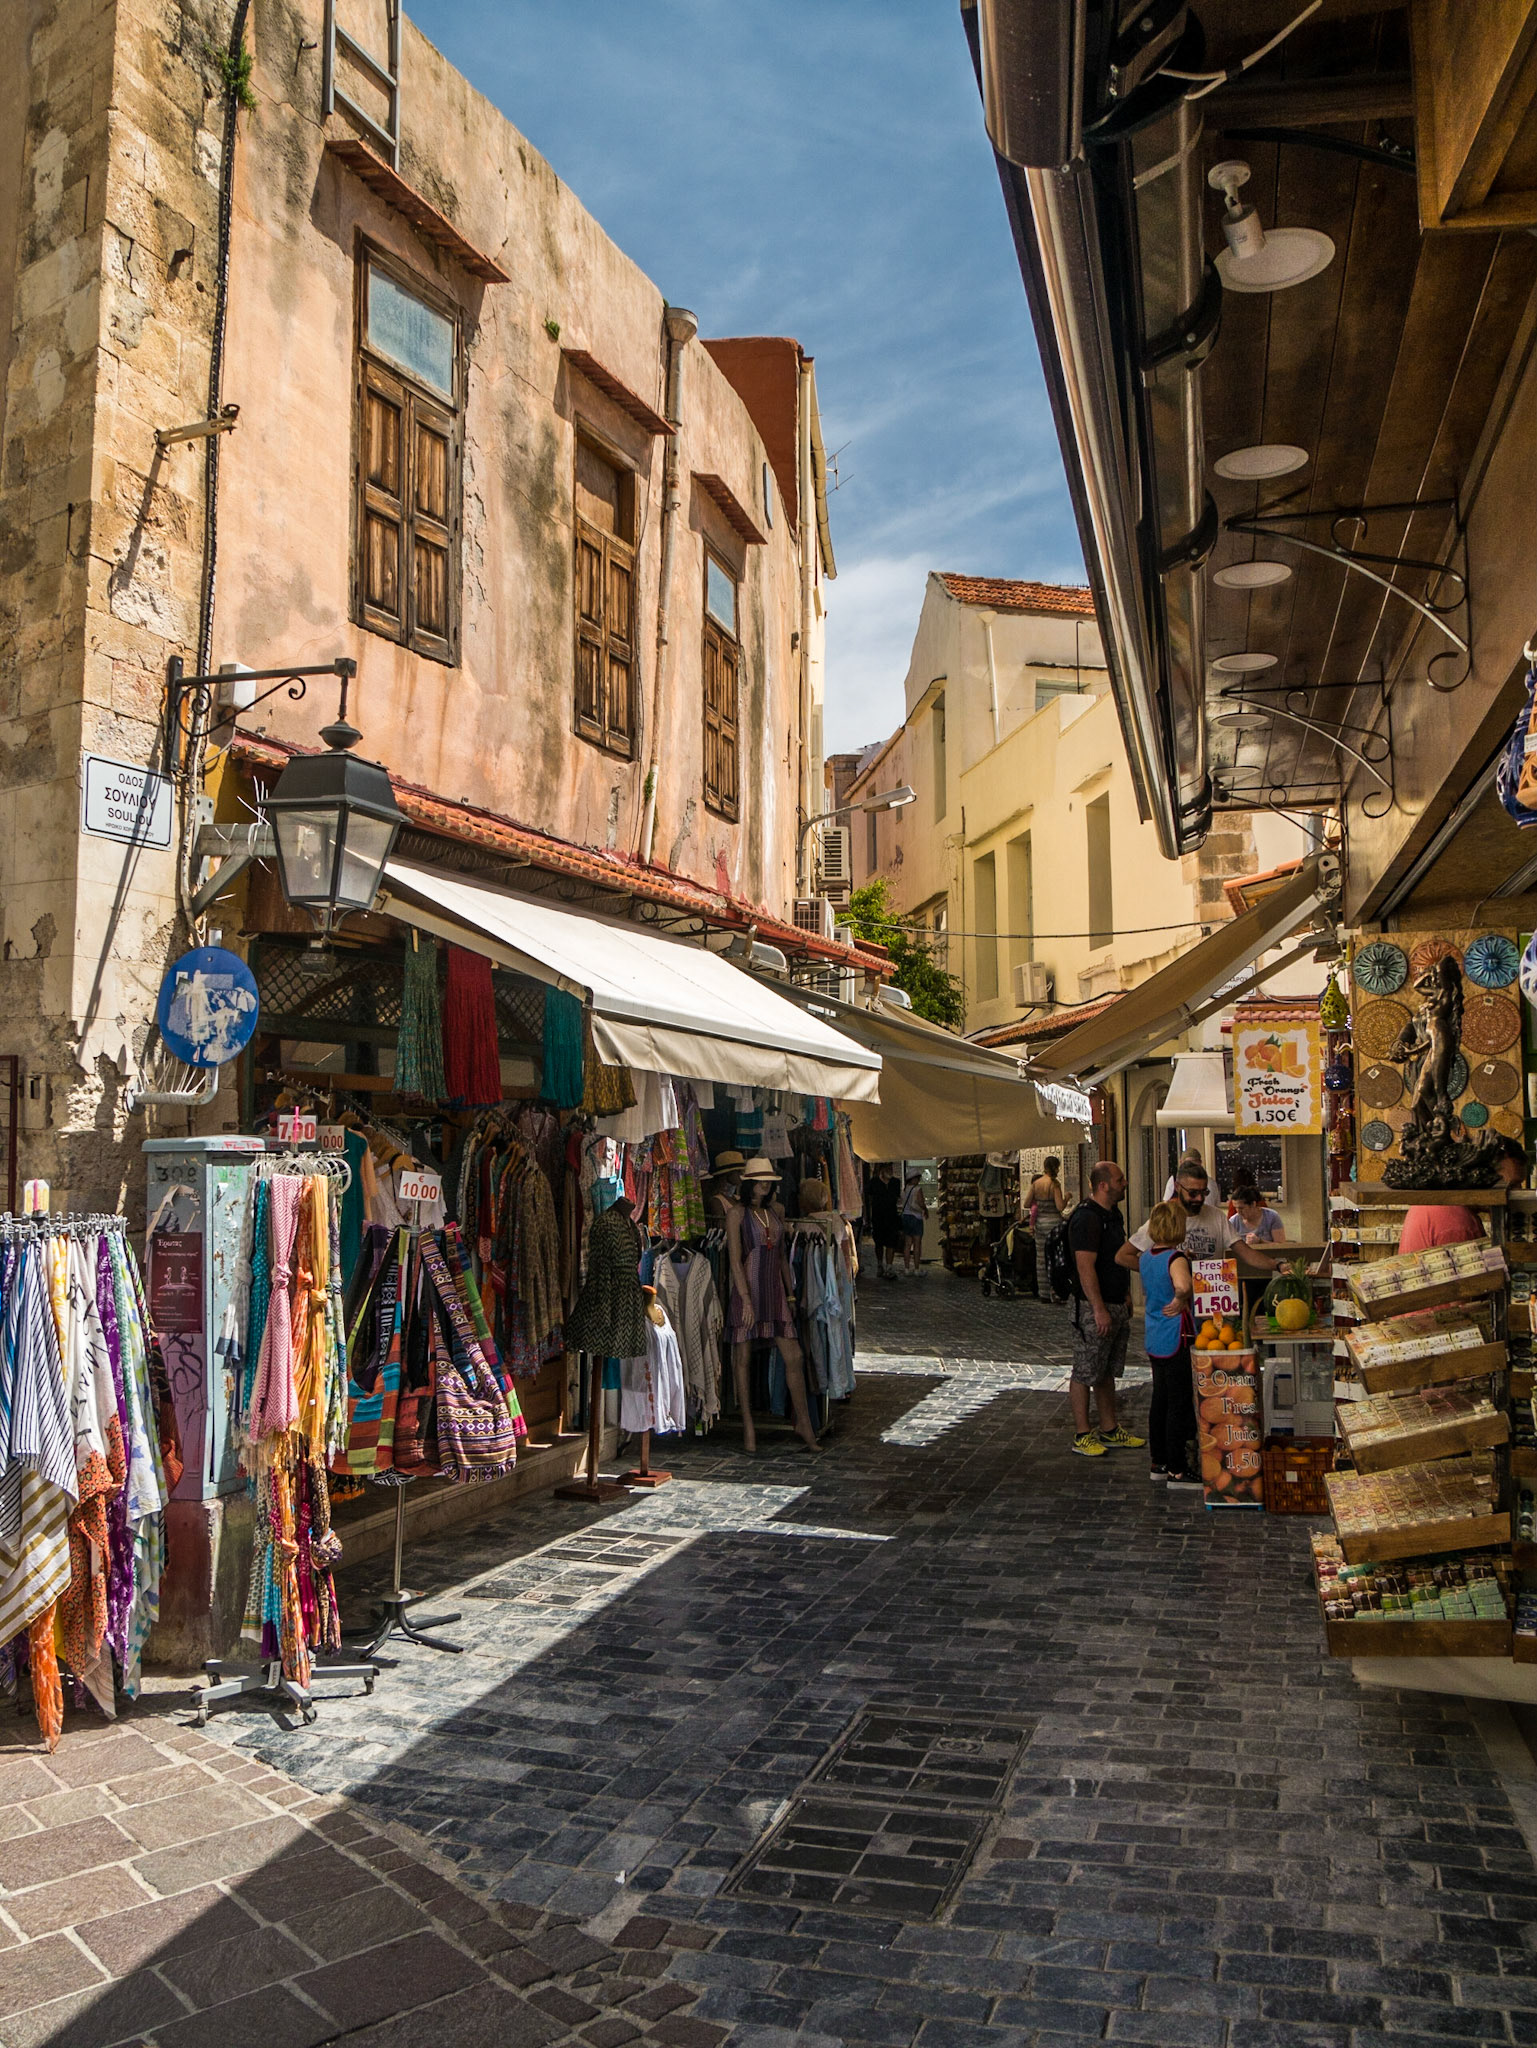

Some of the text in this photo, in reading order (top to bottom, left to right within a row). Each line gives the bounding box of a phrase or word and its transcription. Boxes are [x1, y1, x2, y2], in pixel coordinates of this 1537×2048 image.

[118, 773, 144, 788] ΟΔΟΣ
[104, 787, 156, 810] ΣΟΥΛΙΟΥ
[108, 807, 152, 827] SOULIOU
[1247, 1076, 1280, 1087] Fresh
[1263, 1086, 1305, 1096] Orange
[1247, 1092, 1294, 1109] Juice
[1254, 1109, 1297, 1123] 1,50€
[1199, 1260, 1229, 1271] Fresh
[1194, 1272, 1235, 1283] Orange
[1203, 1282, 1231, 1293] Juice
[1194, 1295, 1239, 1314] 1.50€
[1221, 1396, 1259, 1415] Fres
[1224, 1424, 1260, 1446] Juic
